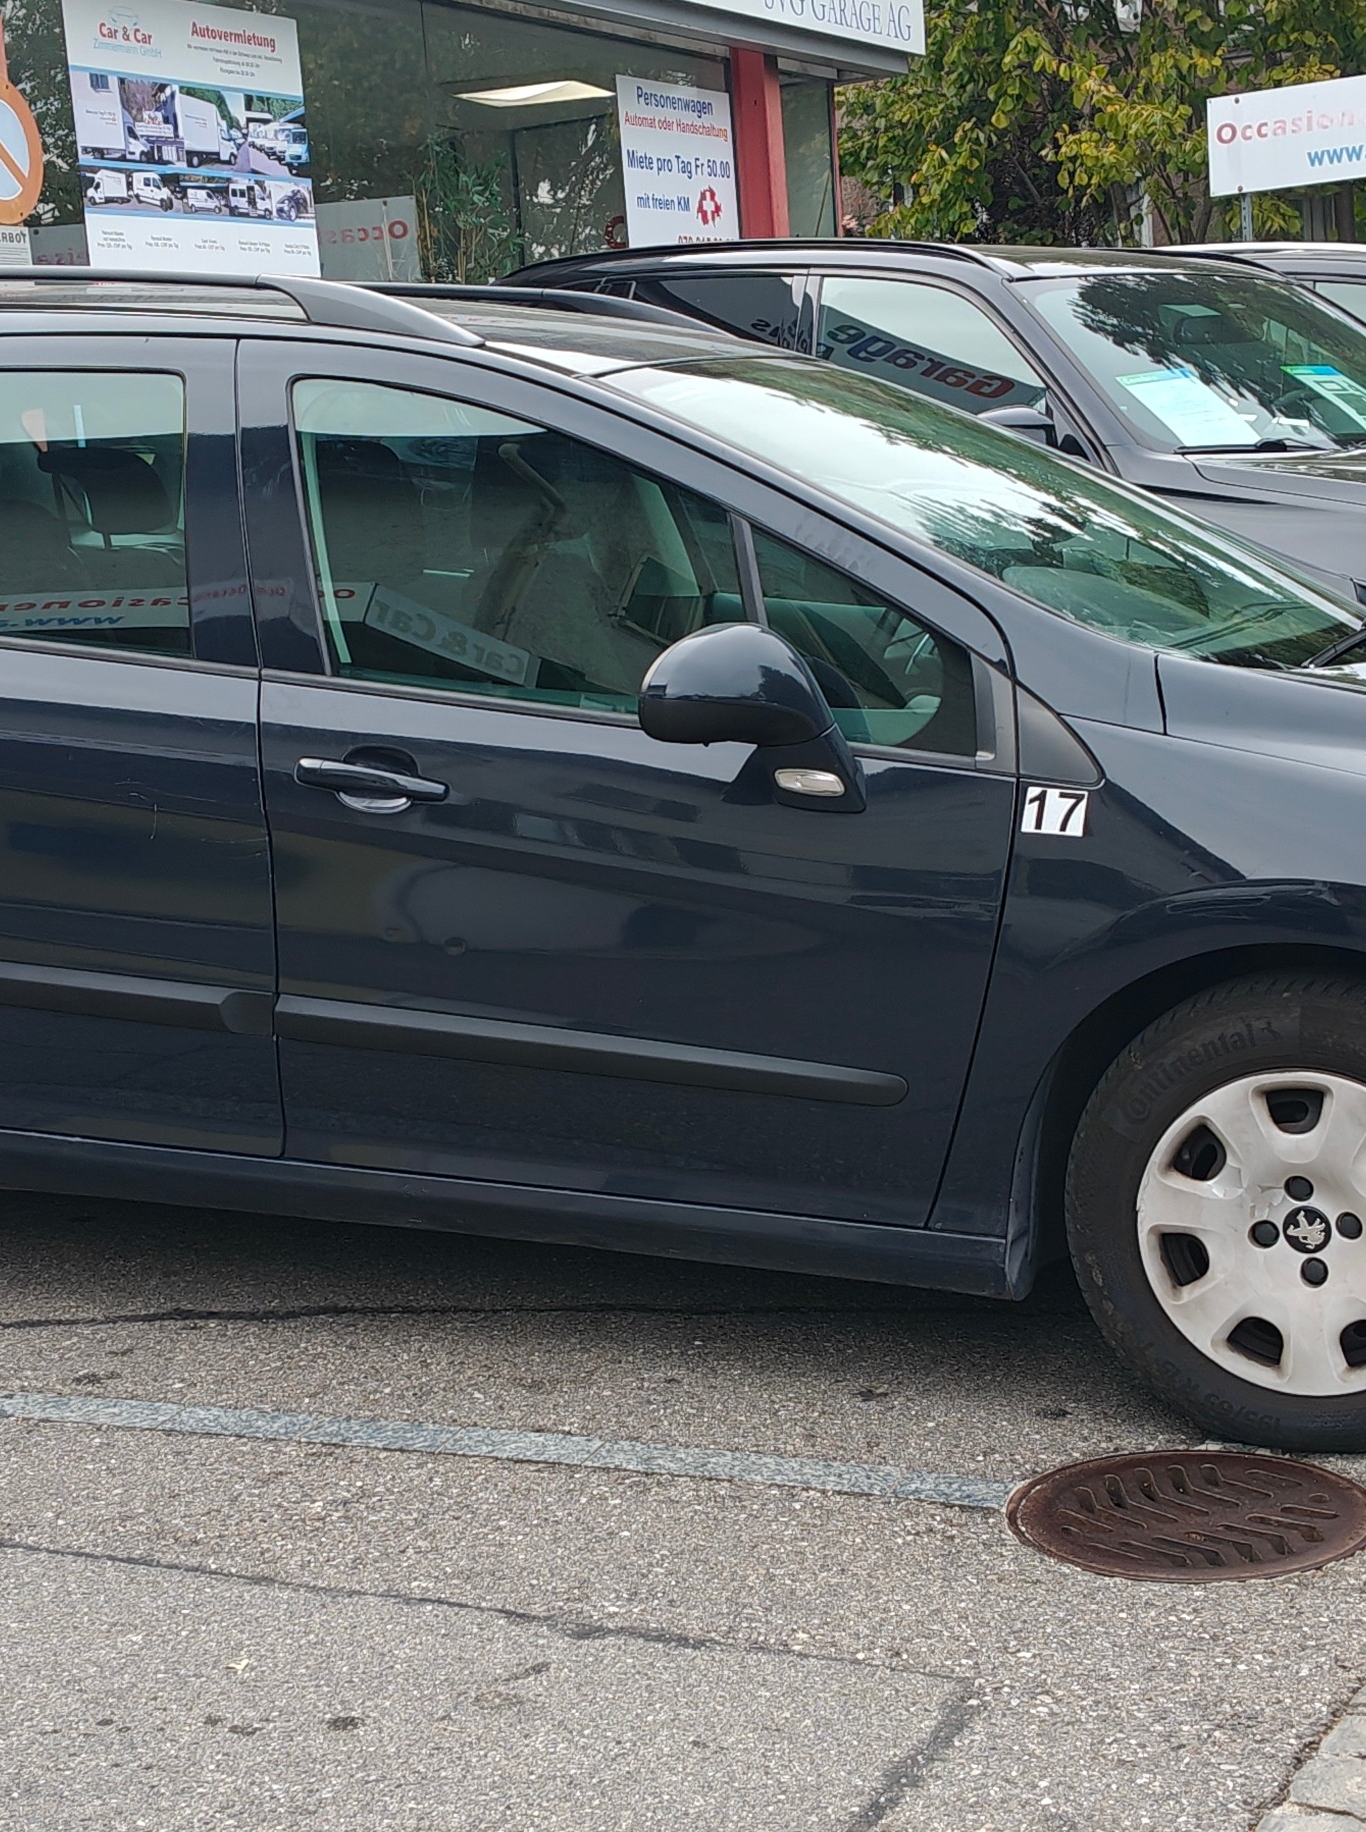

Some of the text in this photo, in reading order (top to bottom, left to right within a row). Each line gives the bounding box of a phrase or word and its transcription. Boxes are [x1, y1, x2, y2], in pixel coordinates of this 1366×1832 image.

[98, 22, 153, 46] Car & Car
[191, 21, 277, 52] Autovermietung
[811, 0, 882, 35] GARAGE
[887, 0, 912, 42] AG
[635, 84, 714, 119] Personenwagen
[623, 110, 729, 143] Automat oder Handschaltung
[626, 148, 732, 180] Miete pro Tag Fr 50.00
[636, 193, 691, 213] mit freien KM
[1027, 789, 1087, 833] 17
